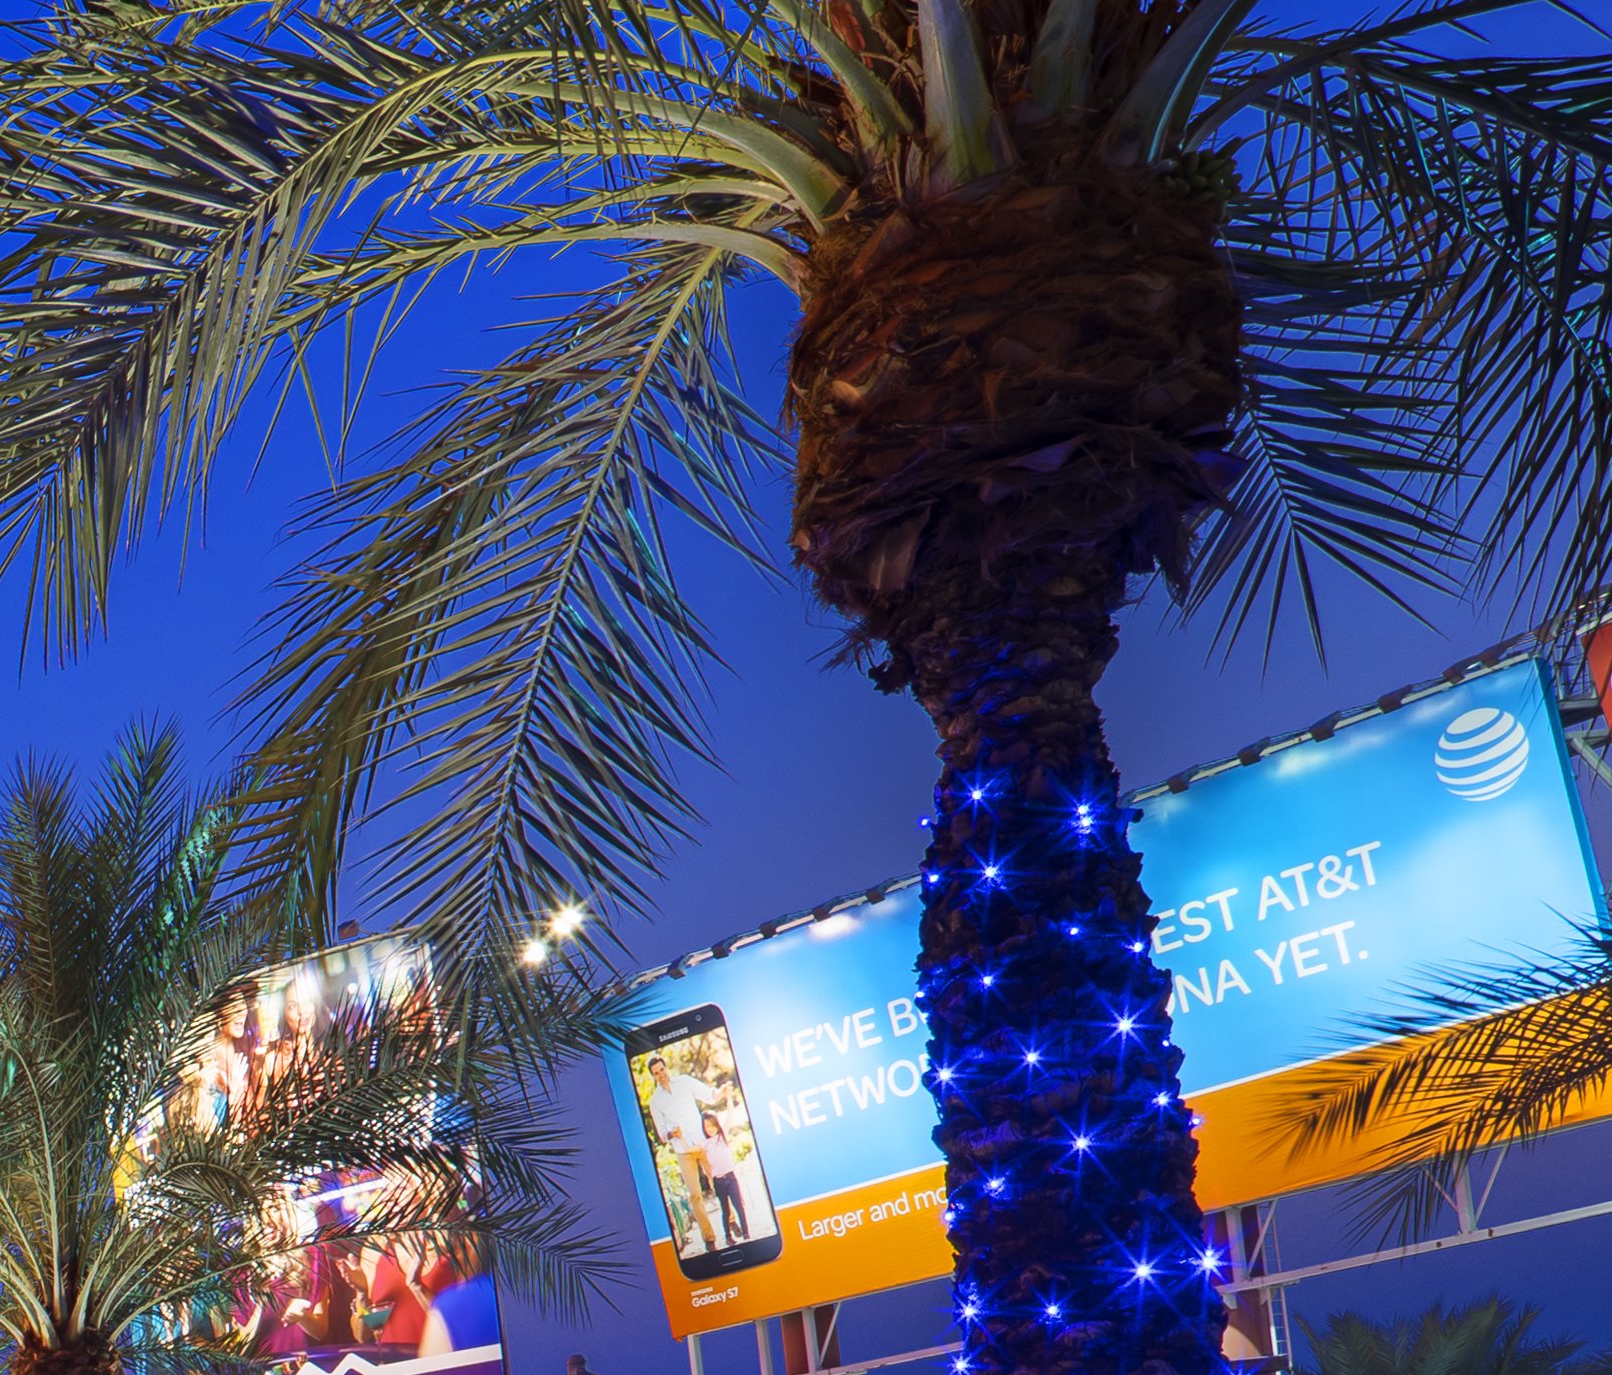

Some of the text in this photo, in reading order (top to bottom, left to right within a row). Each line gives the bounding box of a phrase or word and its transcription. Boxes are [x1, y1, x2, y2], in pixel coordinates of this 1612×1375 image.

[1152, 841, 1382, 956] EST AT&T
[1255, 920, 1369, 987] YET.
[659, 1026, 689, 1042] SAMSUNG
[754, 1008, 883, 1080] WE'VE
[768, 1053, 932, 1135] NETWO
[799, 1185, 947, 1242] Larger and mo
[691, 1286, 739, 1309] Galaxy S7
